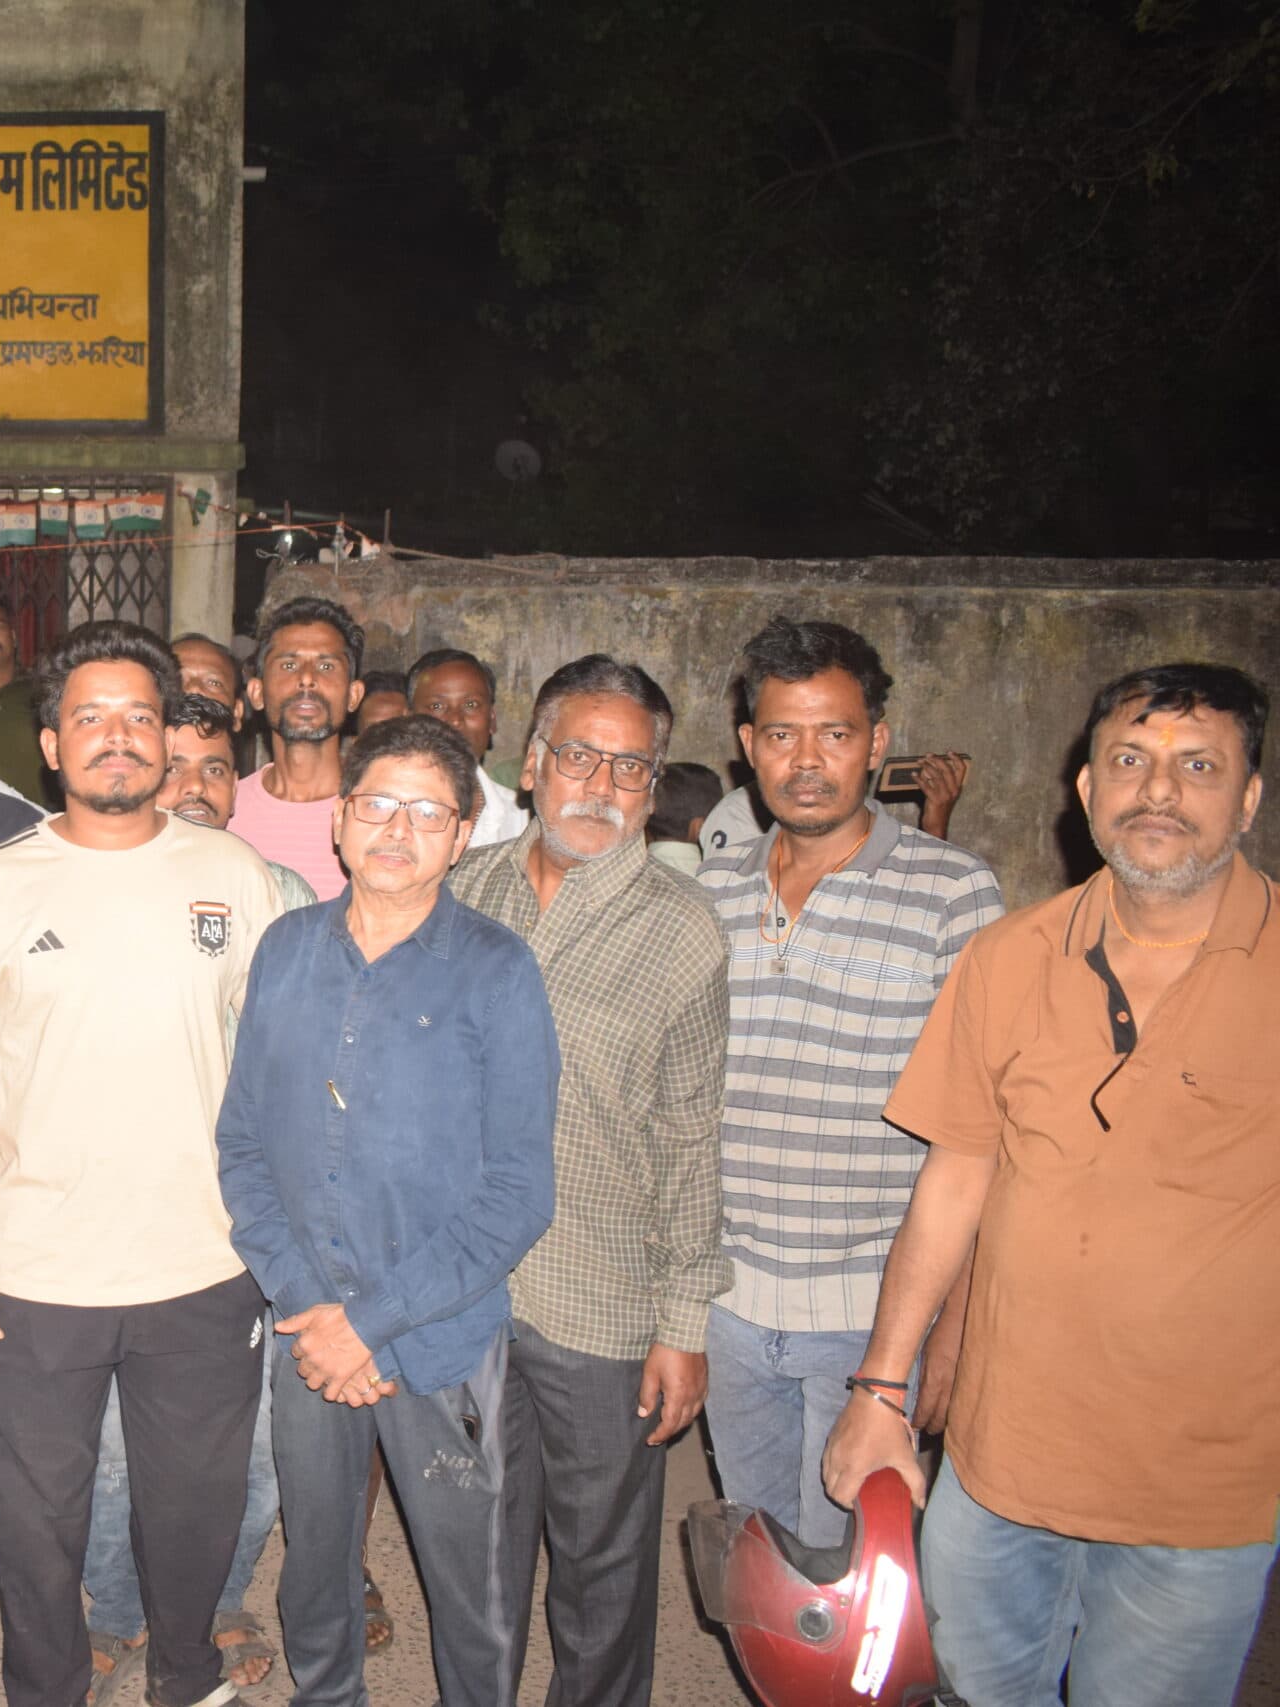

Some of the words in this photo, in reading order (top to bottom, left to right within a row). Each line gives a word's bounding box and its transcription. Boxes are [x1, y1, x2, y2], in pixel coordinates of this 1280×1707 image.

[31, 139, 147, 211] लिमिटेड
[77, 336, 146, 367] झरिया
[201, 915, 224, 943] AFA
